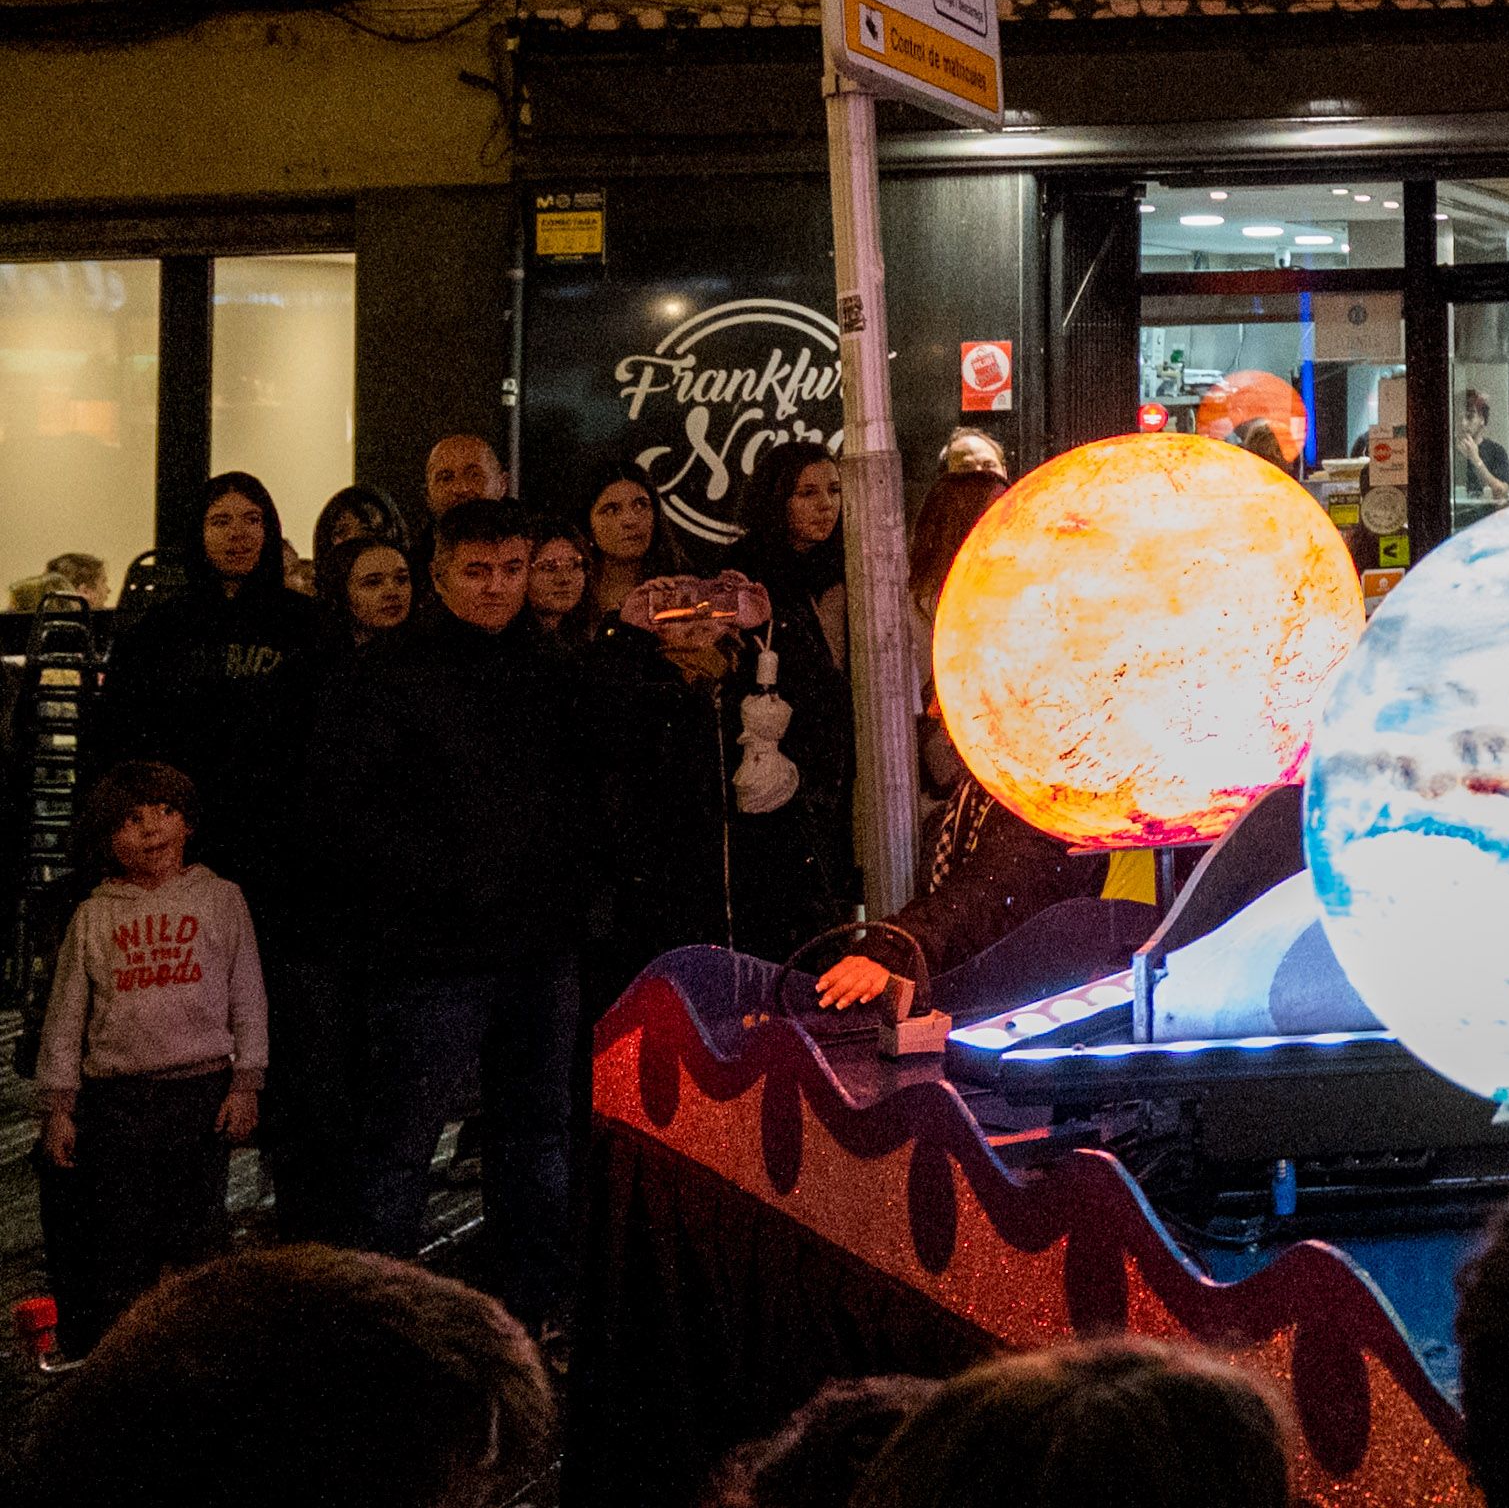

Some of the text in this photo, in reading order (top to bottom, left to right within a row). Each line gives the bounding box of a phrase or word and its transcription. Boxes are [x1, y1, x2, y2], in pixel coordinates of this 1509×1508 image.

[889, 27, 925, 62] Control
[928, 46, 940, 69] de
[111, 914, 199, 952] WILD
[111, 947, 203, 992] woods
[125, 946, 181, 966] IN THE
